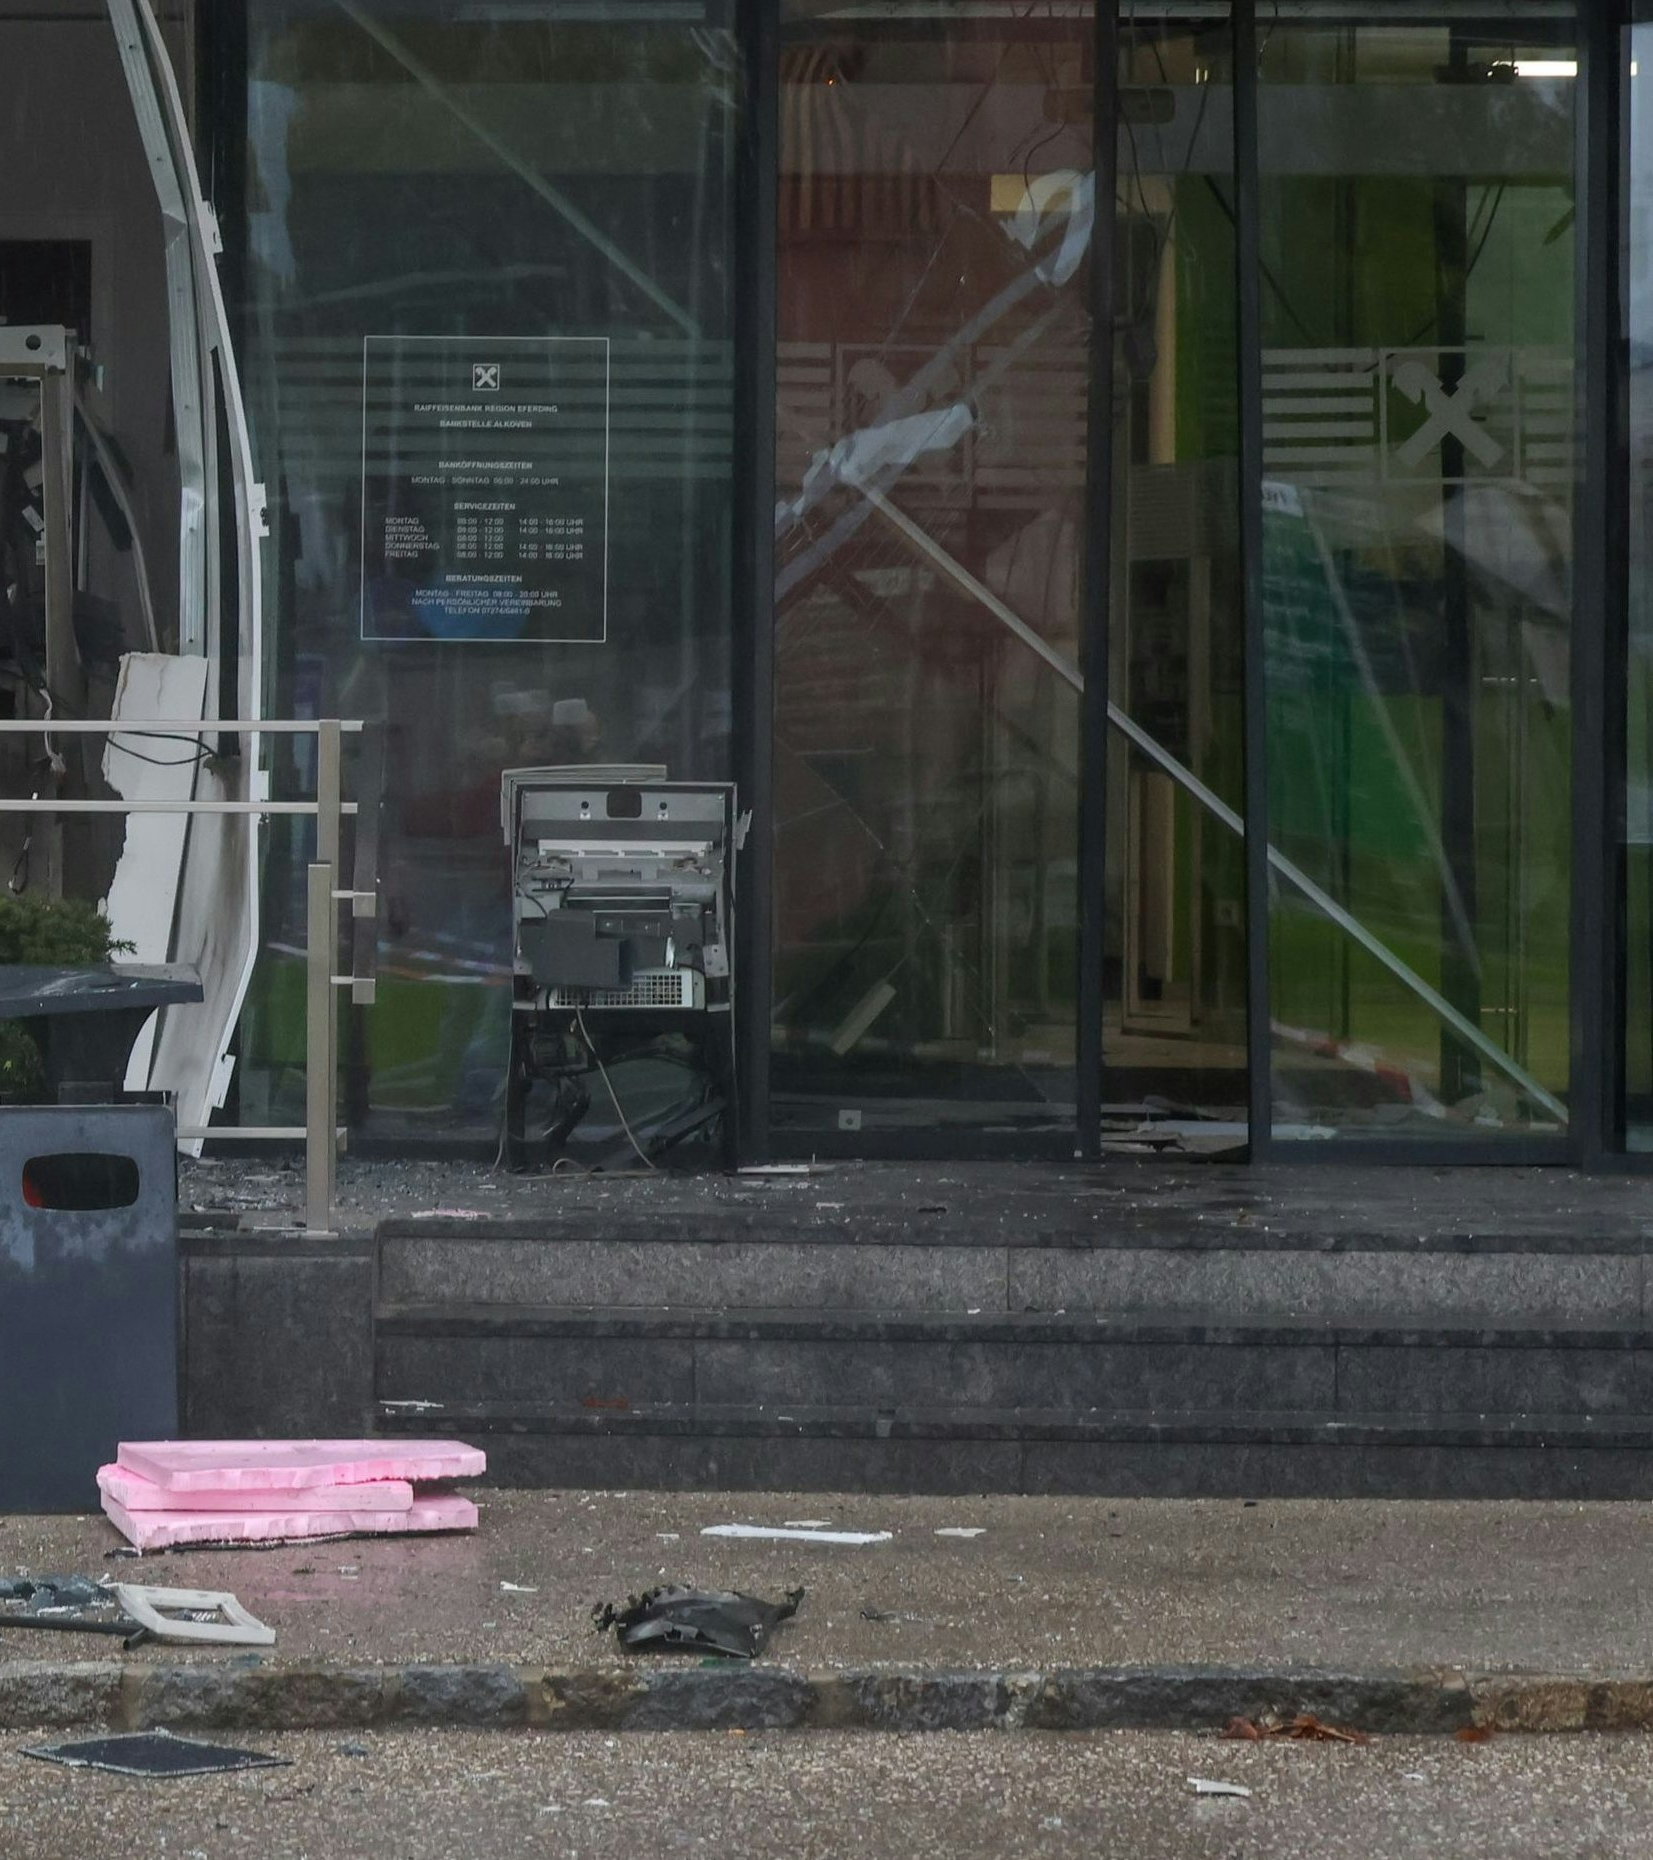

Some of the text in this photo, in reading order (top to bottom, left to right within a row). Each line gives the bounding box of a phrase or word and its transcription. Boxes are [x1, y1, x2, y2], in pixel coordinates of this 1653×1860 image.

[414, 404, 483, 412] RAIFFEISENBANK
[517, 405, 558, 413] EFERDING
[438, 461, 533, 469] BANKÖFFNUNGSZEITEN
[411, 476, 445, 484] MONTAG
[385, 542, 440, 550] DONNERSTAG
[385, 550, 419, 558] FREITAG
[436, 598, 497, 606] PERSÖNLICHER
[499, 599, 562, 607] VEREINBARUNG
